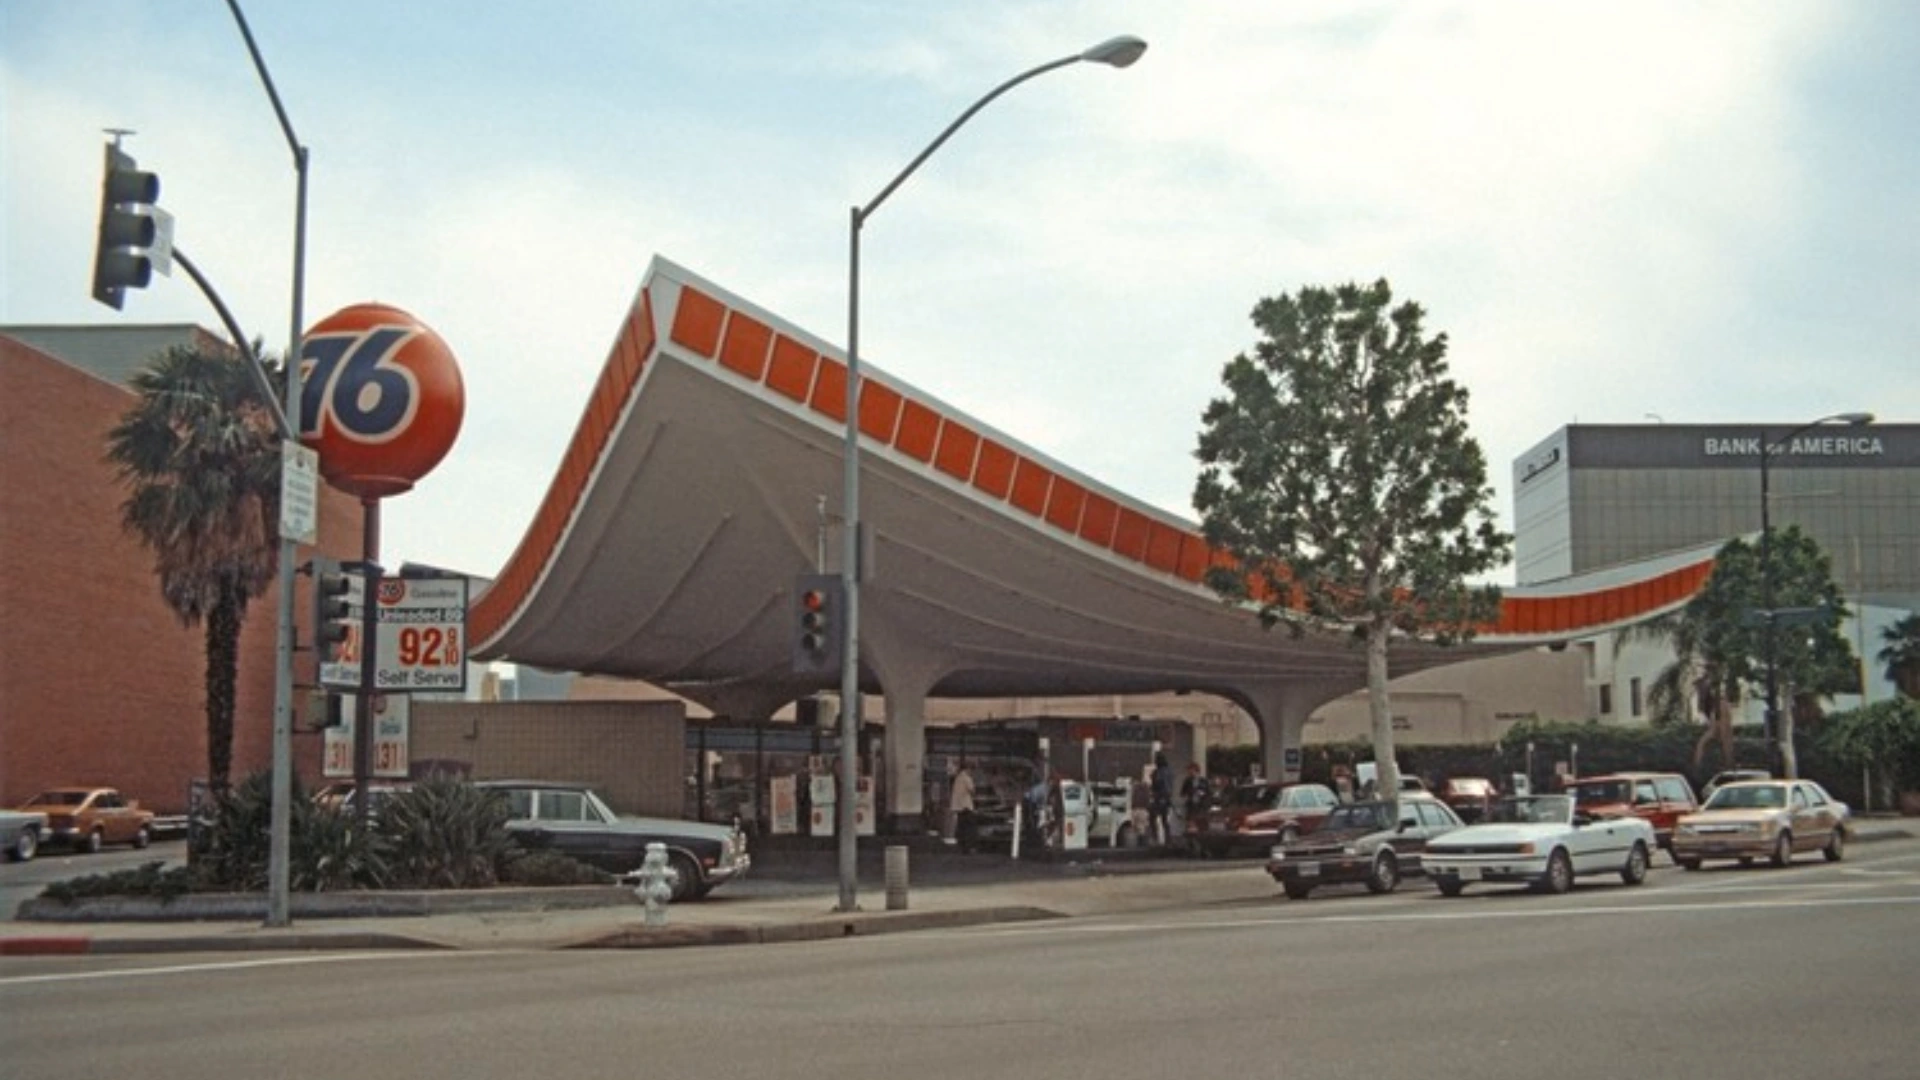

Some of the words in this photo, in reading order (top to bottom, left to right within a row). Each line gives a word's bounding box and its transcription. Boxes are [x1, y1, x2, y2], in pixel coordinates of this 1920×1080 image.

[301, 326, 418, 442] 76
[1704, 437, 1760, 455] BANK
[1790, 437, 1884, 455] AMERICA
[399, 627, 442, 666] 92
[378, 669, 408, 684] Self
[414, 669, 459, 684] Serve
